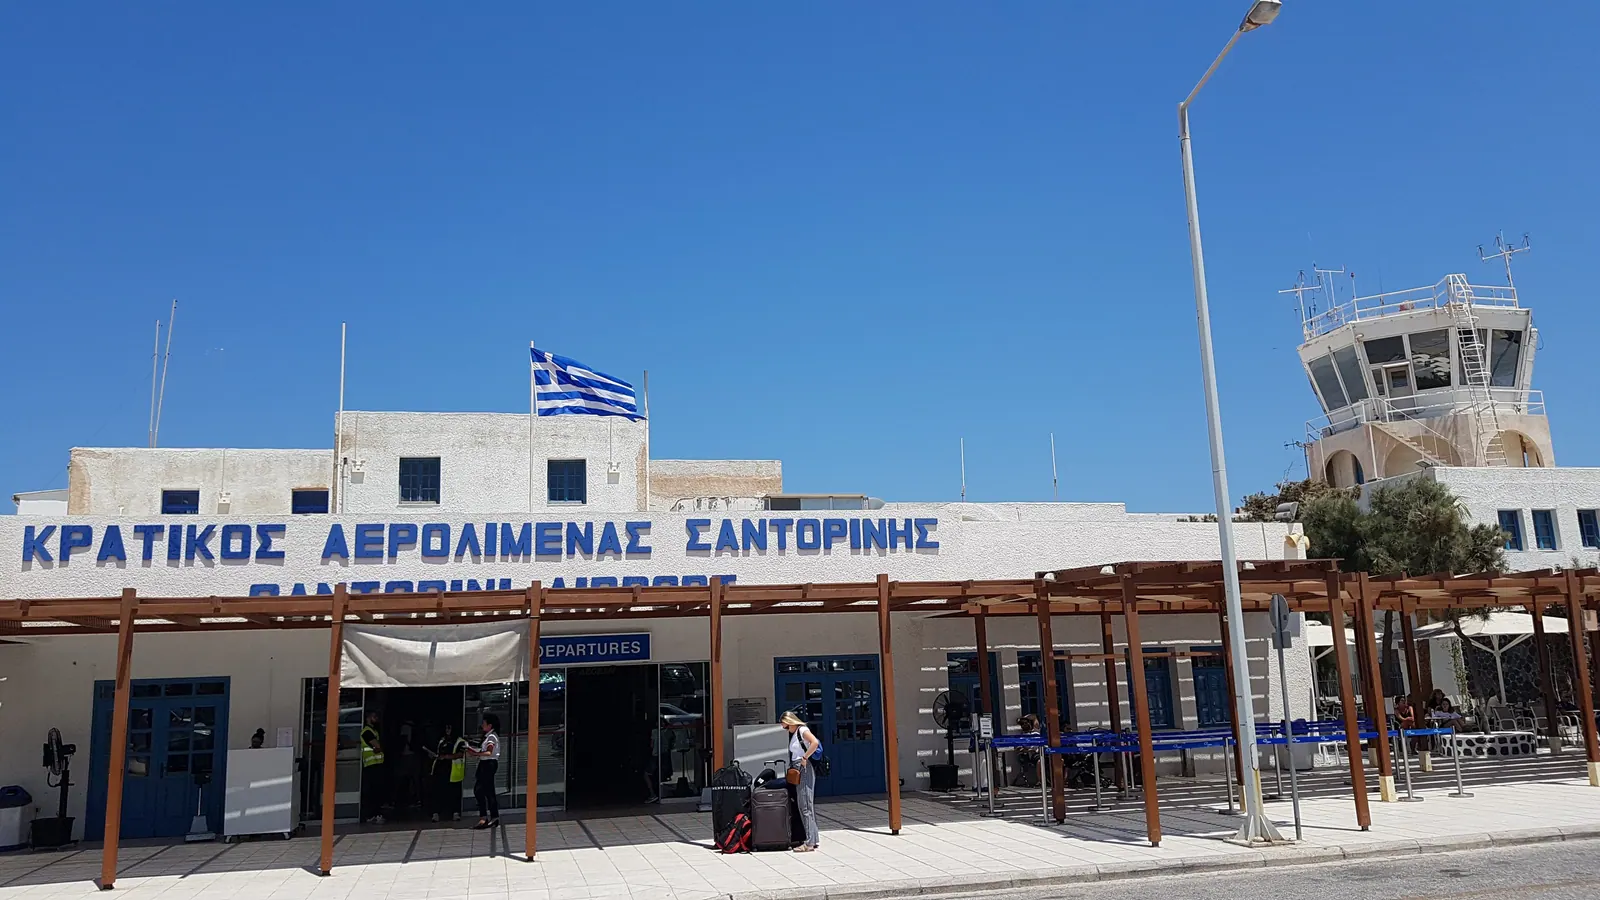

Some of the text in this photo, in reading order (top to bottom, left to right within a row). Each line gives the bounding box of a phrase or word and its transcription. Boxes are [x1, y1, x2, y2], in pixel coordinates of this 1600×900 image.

[23, 518, 940, 562] ΚΡΑΤΙΚΟΣ ΑΕΡΟΛΙΜΕΝΑΣ ΣΑΝΤΟΡΙΝΗΣ
